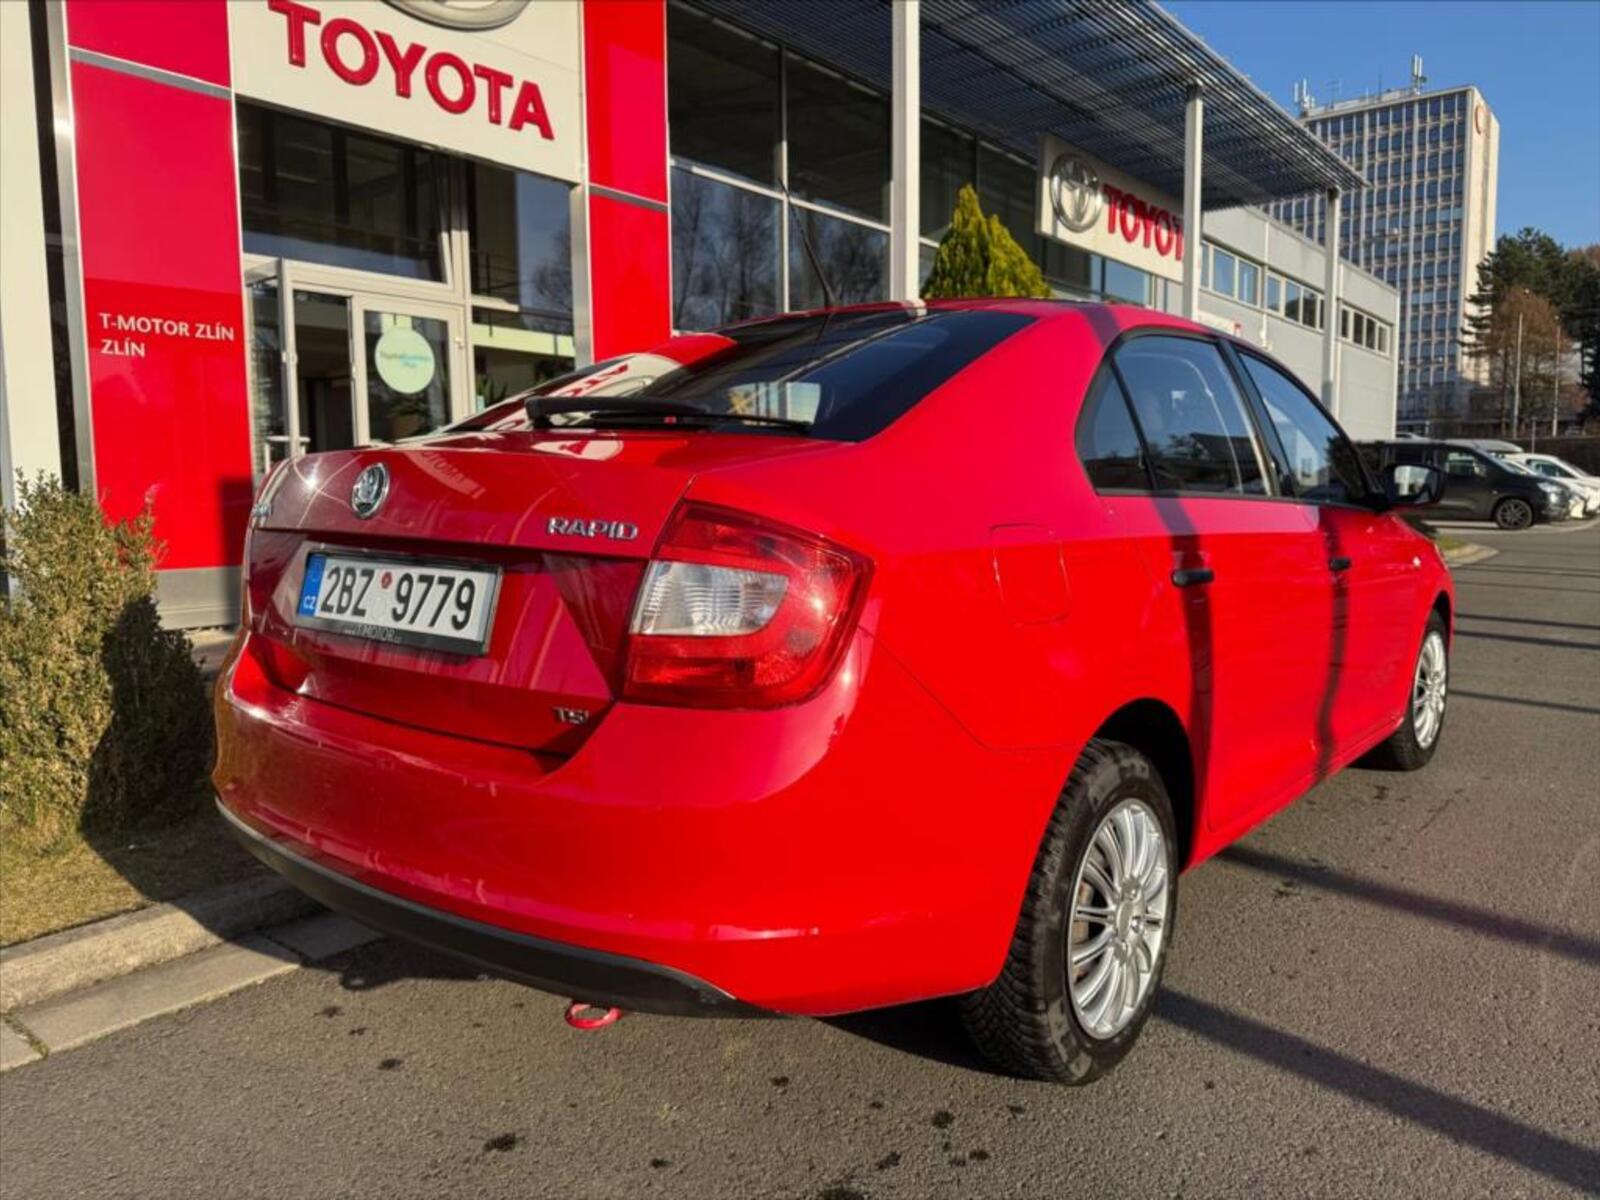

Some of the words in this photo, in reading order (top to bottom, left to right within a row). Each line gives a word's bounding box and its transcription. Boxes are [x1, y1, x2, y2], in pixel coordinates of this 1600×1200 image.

[267, 0, 555, 142] TOYOTA
[1102, 183, 1184, 262] TOYOT
[98, 311, 190, 337] T-MOTOR
[194, 321, 235, 341] ZLÍN
[100, 336, 146, 357] ZLÍN
[547, 516, 638, 540] RAPID
[303, 595, 317, 610] CZ
[320, 566, 375, 618] 2BZ
[391, 572, 476, 631] 9779
